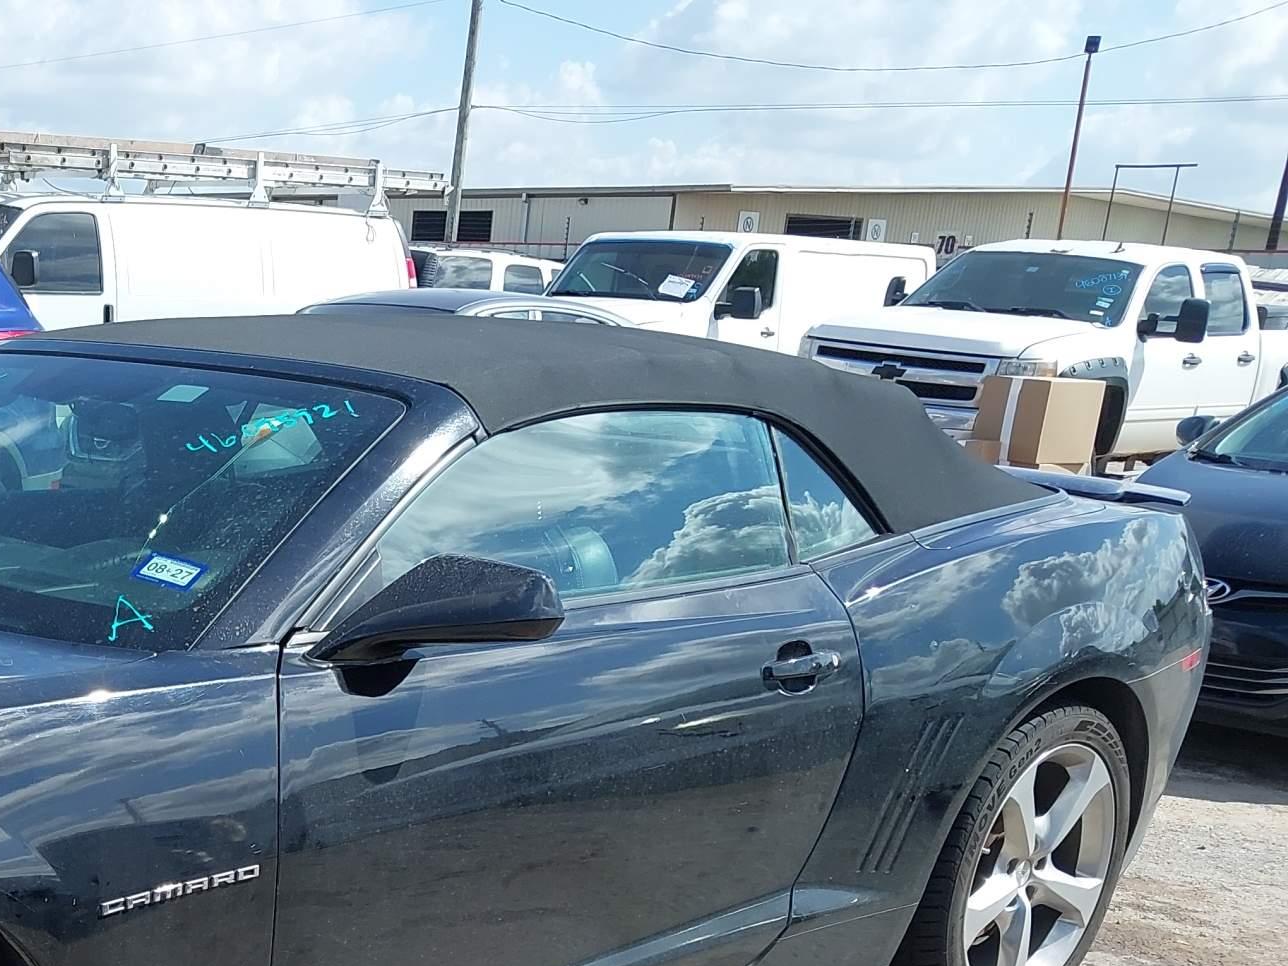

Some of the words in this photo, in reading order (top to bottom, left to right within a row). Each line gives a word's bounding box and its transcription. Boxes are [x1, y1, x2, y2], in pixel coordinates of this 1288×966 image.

[937, 235, 956, 255] 70
[146, 562, 168, 574] 08
[170, 568, 193, 581] 27
[108, 594, 153, 642] A
[1008, 737, 1042, 781] Gen2
[100, 863, 260, 917] CAMARO
